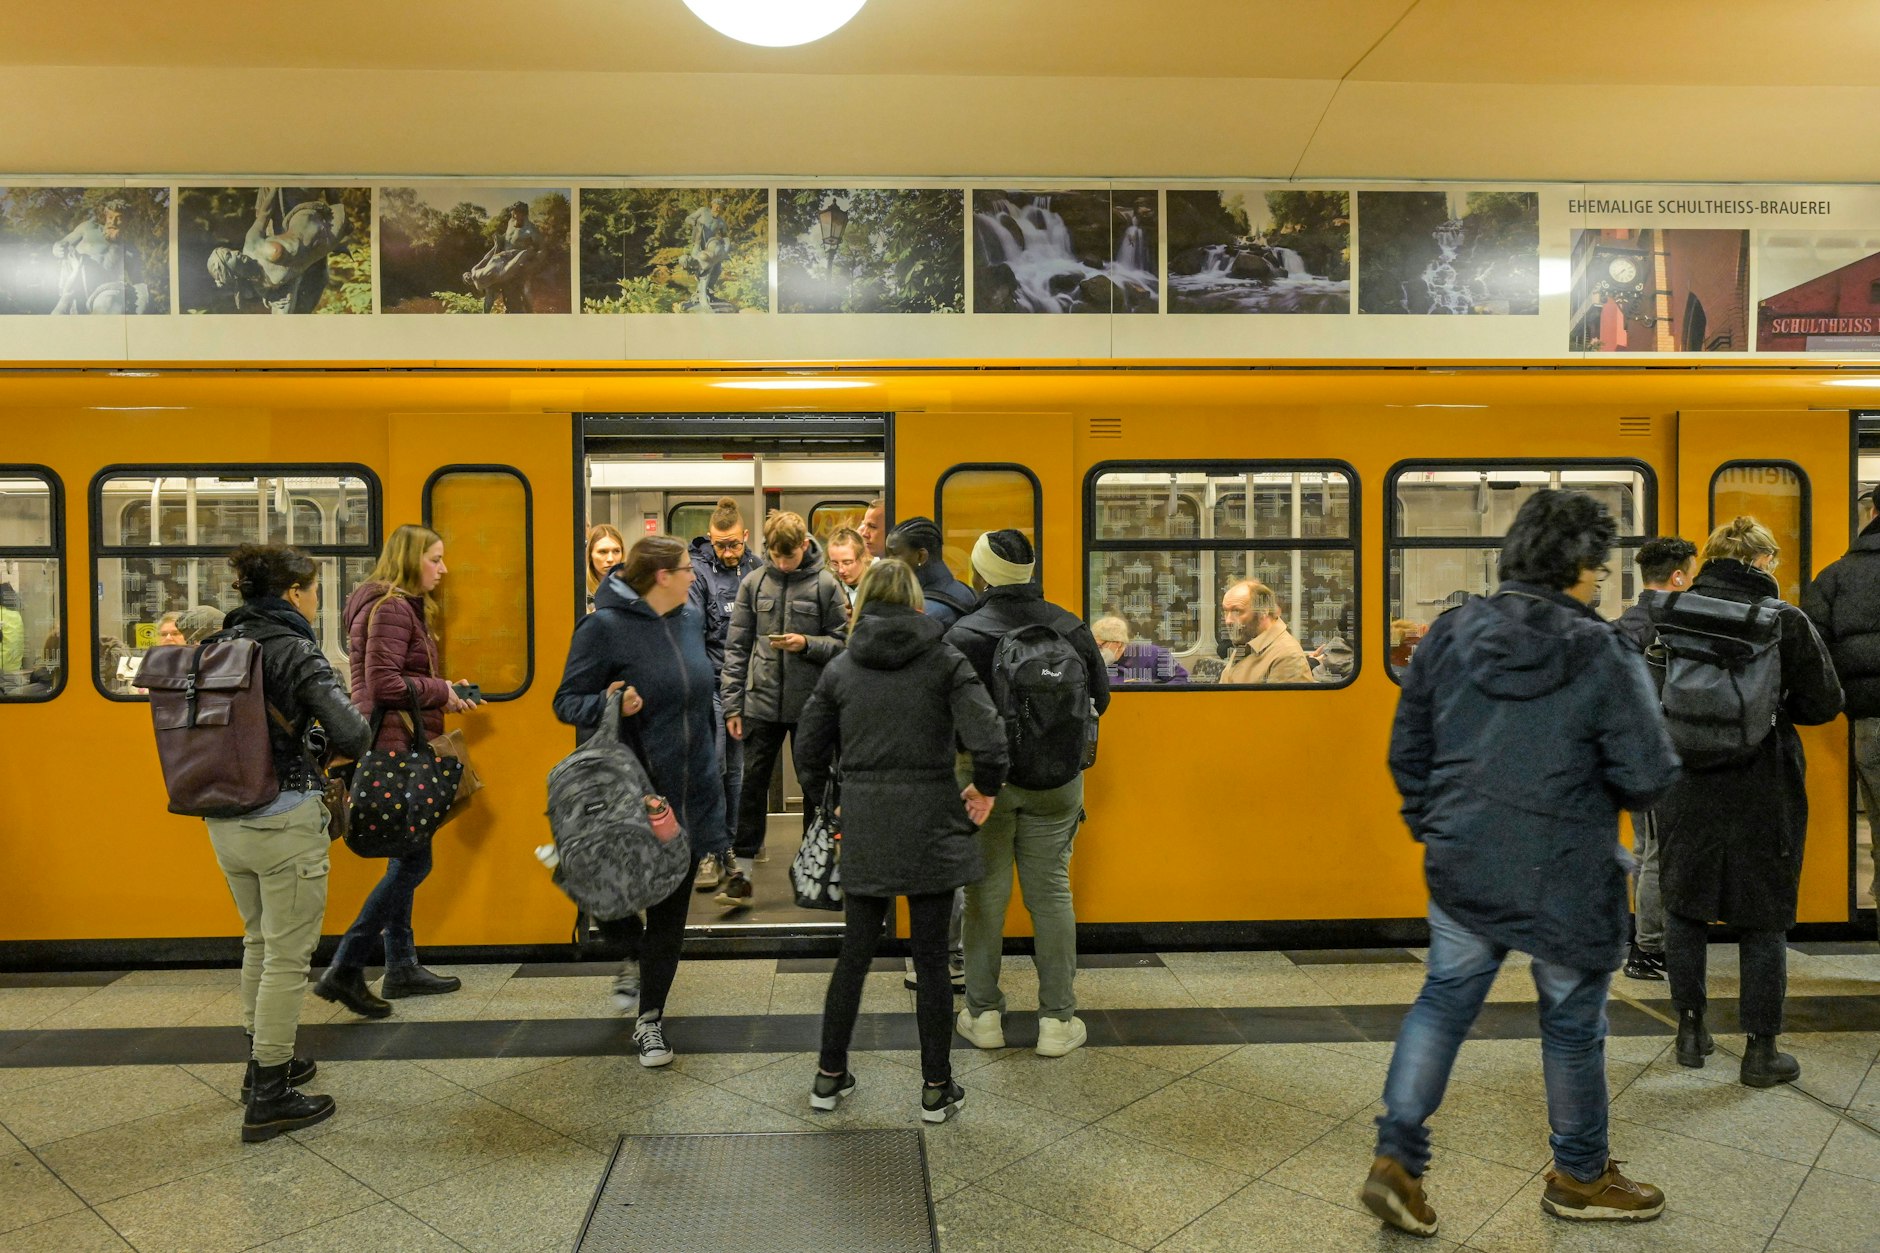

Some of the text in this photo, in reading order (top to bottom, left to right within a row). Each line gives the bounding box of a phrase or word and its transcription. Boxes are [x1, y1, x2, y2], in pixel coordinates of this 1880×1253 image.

[1568, 199, 1831, 215] EHEMALIGE SCHULTHEISS-BRAUEREI
[1772, 317, 1872, 334] SCHULTHEISS
